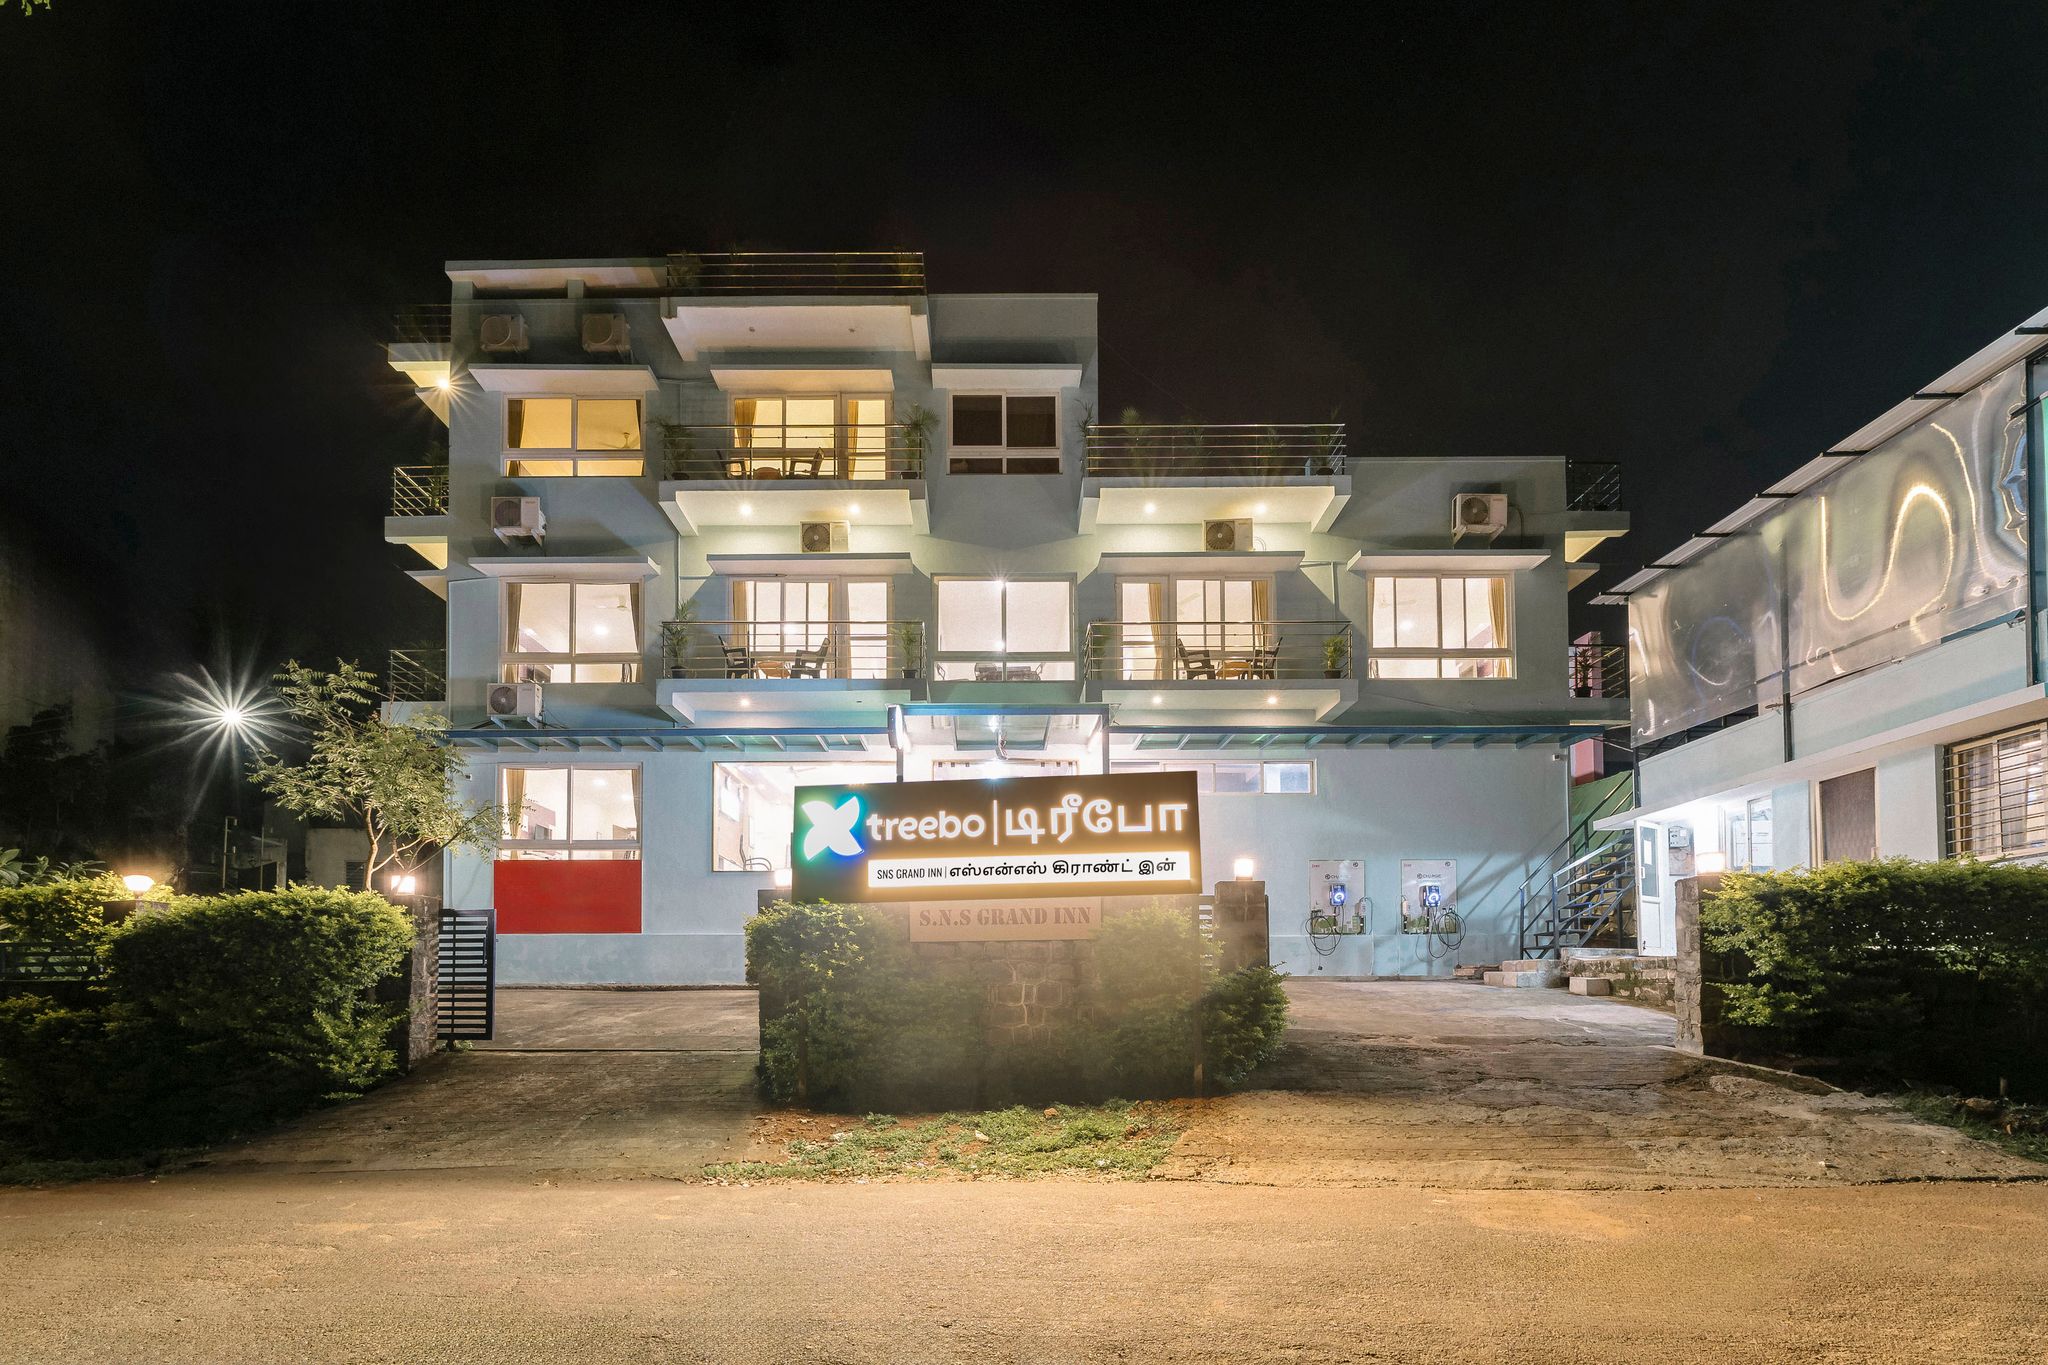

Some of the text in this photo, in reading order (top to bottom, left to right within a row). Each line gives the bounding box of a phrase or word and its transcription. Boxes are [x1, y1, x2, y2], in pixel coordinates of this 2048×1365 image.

[866, 810, 985, 841] treebo
[1005, 793, 1188, 844] டிரீபோ
[877, 867, 943, 880] SNS GRAND INN
[949, 857, 1176, 877] எஸ்என்எஸ் கிராண்ட் இன்
[919, 906, 1091, 927] S.N.S GRAND INN
